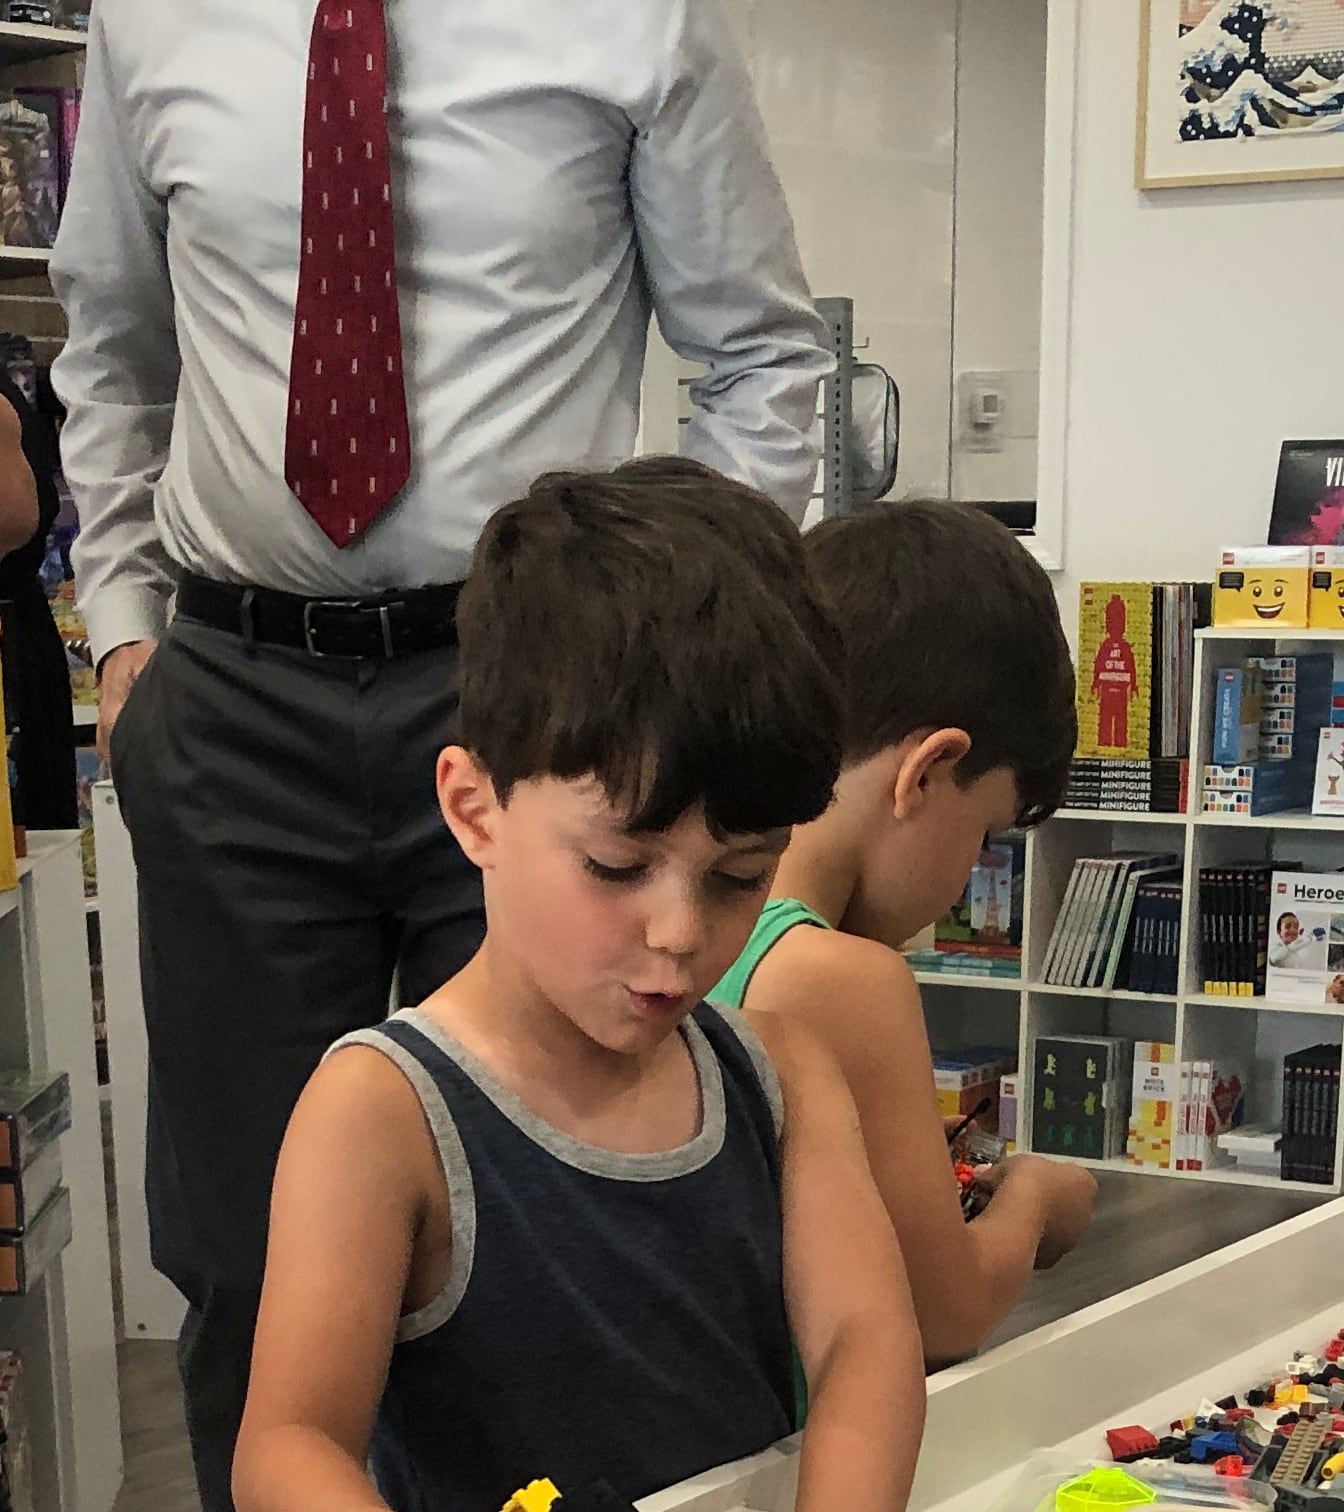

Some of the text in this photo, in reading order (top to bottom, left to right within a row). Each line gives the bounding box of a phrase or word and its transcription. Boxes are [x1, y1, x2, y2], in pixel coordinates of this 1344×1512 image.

[1100, 770, 1152, 780] MINIFIGURE
[1101, 781, 1152, 791] MINIFIGURE
[1100, 791, 1151, 801] MINIFIGURE
[1098, 801, 1150, 811] MINIFIGURE
